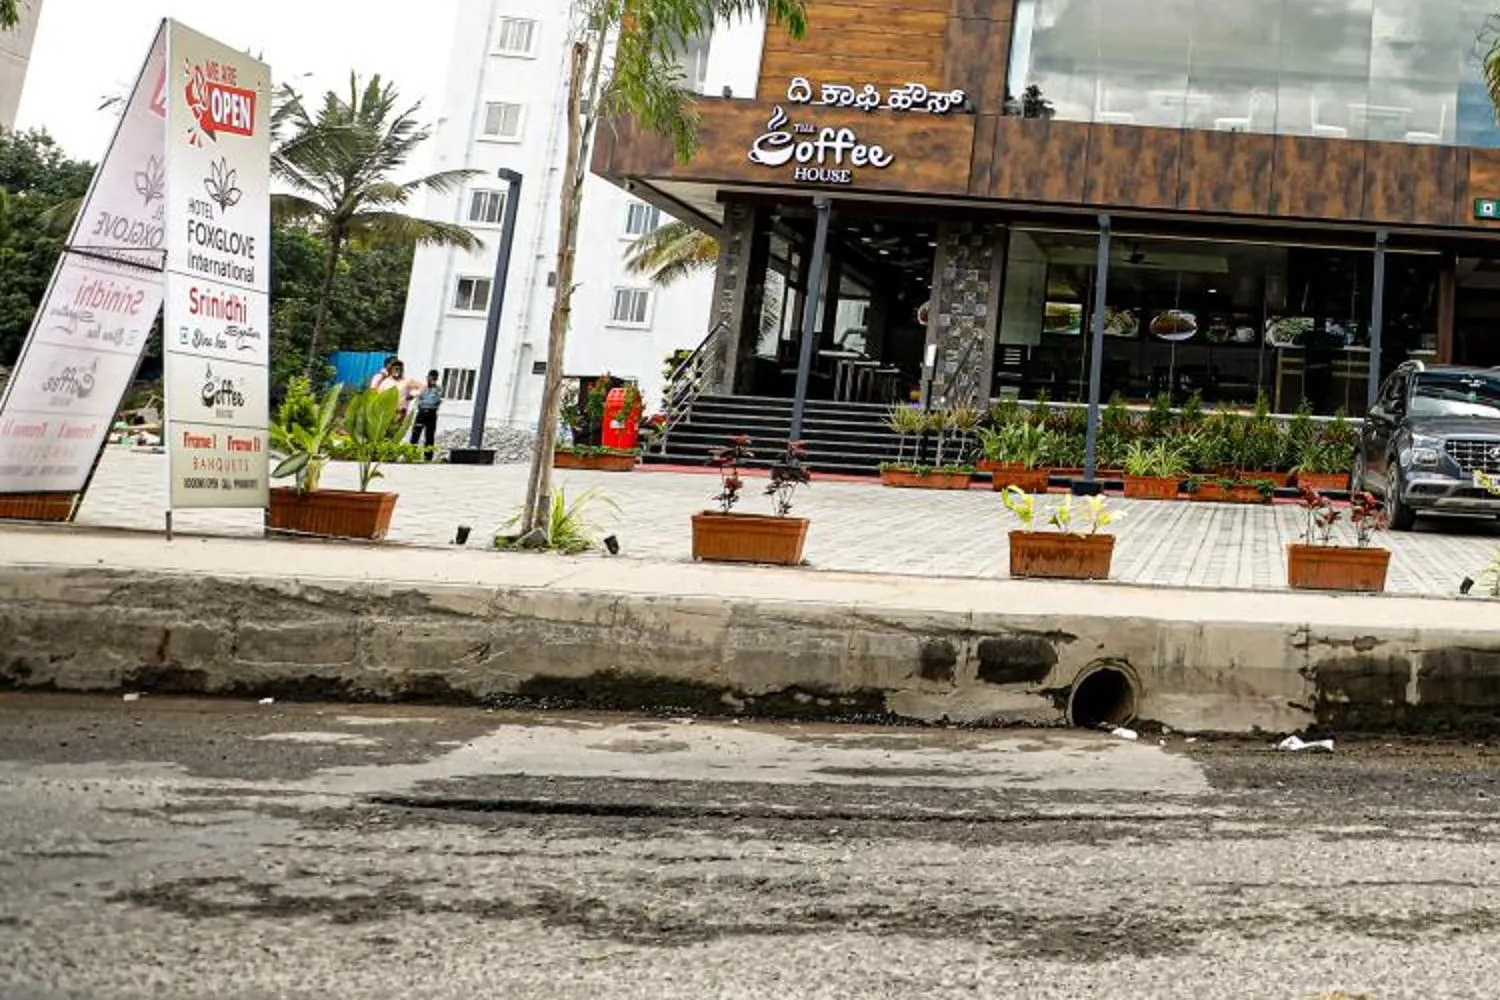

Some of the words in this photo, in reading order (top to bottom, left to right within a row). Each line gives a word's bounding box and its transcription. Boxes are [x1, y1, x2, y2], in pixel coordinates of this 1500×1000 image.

[211, 87, 252, 130] OPEN
[748, 128, 894, 167] Coffee
[794, 167, 851, 183] HOUSE
[187, 219, 255, 259] FOXGLOVE
[187, 249, 255, 283] International
[189, 286, 247, 324] Srinidhi
[193, 456, 249, 472] BANQUETS
